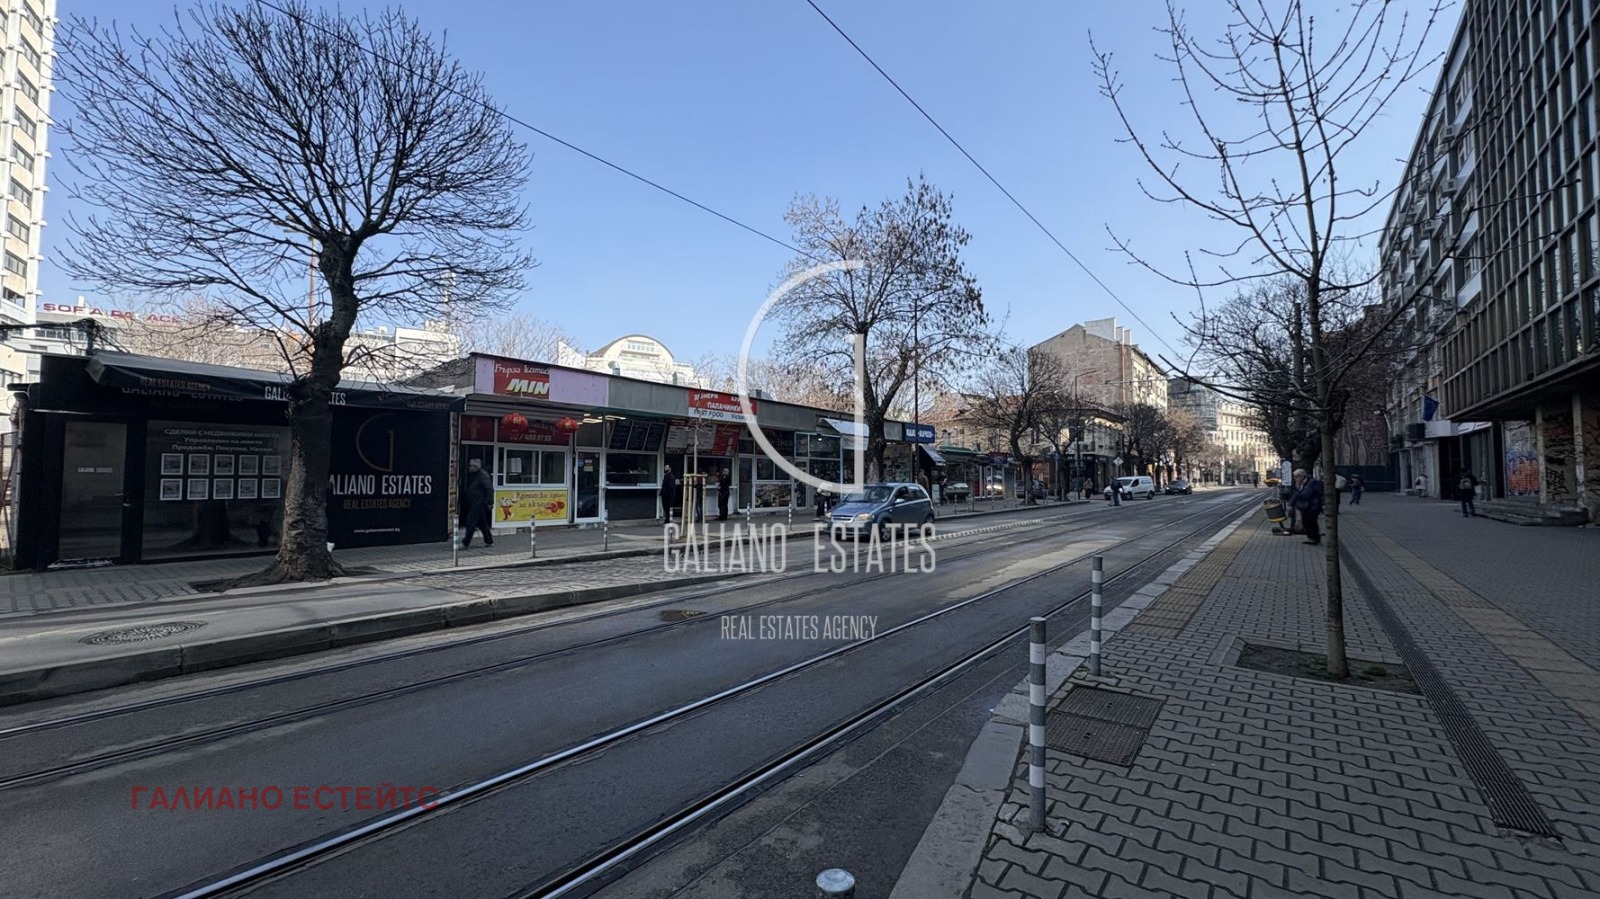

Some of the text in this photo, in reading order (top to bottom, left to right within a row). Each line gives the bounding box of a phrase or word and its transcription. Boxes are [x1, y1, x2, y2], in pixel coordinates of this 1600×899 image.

[43, 303, 103, 316] SOFA
[329, 474, 432, 495] ALIANO ESTATES
[343, 498, 412, 510] REAL ESTATES AGENCY
